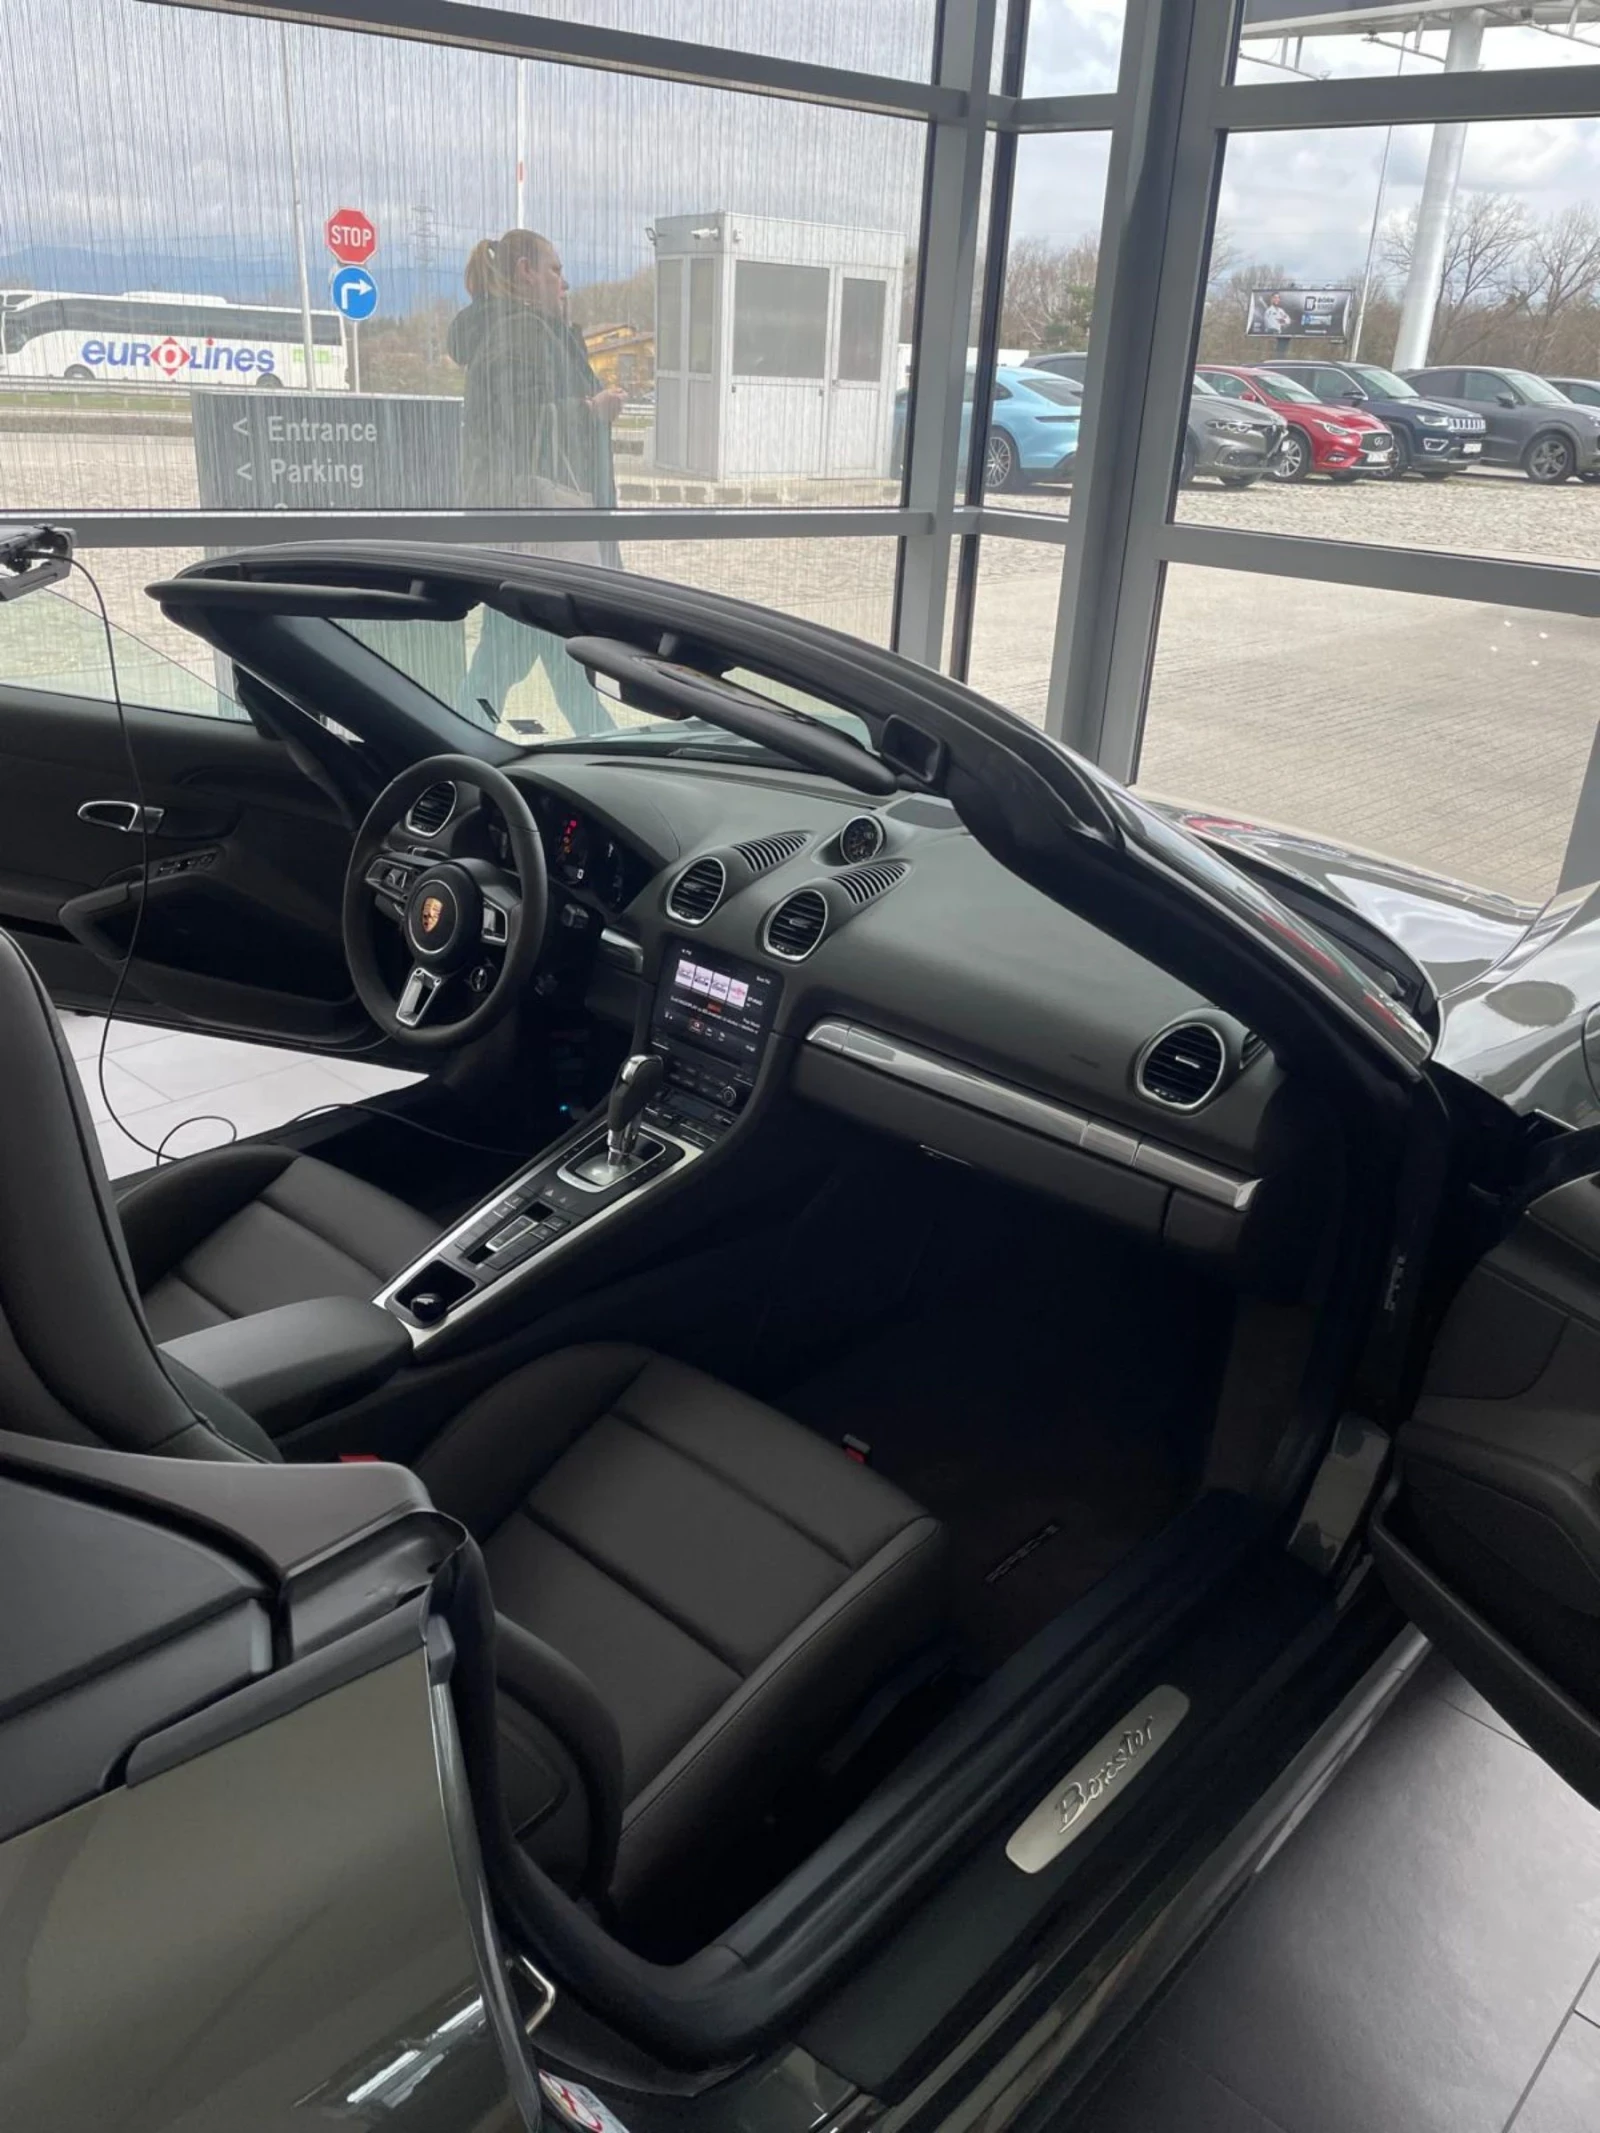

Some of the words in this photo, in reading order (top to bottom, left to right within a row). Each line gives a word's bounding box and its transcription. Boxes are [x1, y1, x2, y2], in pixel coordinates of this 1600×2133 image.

[331, 224, 372, 248] STOP
[267, 415, 377, 441] Entrance
[270, 458, 364, 488] Parking
